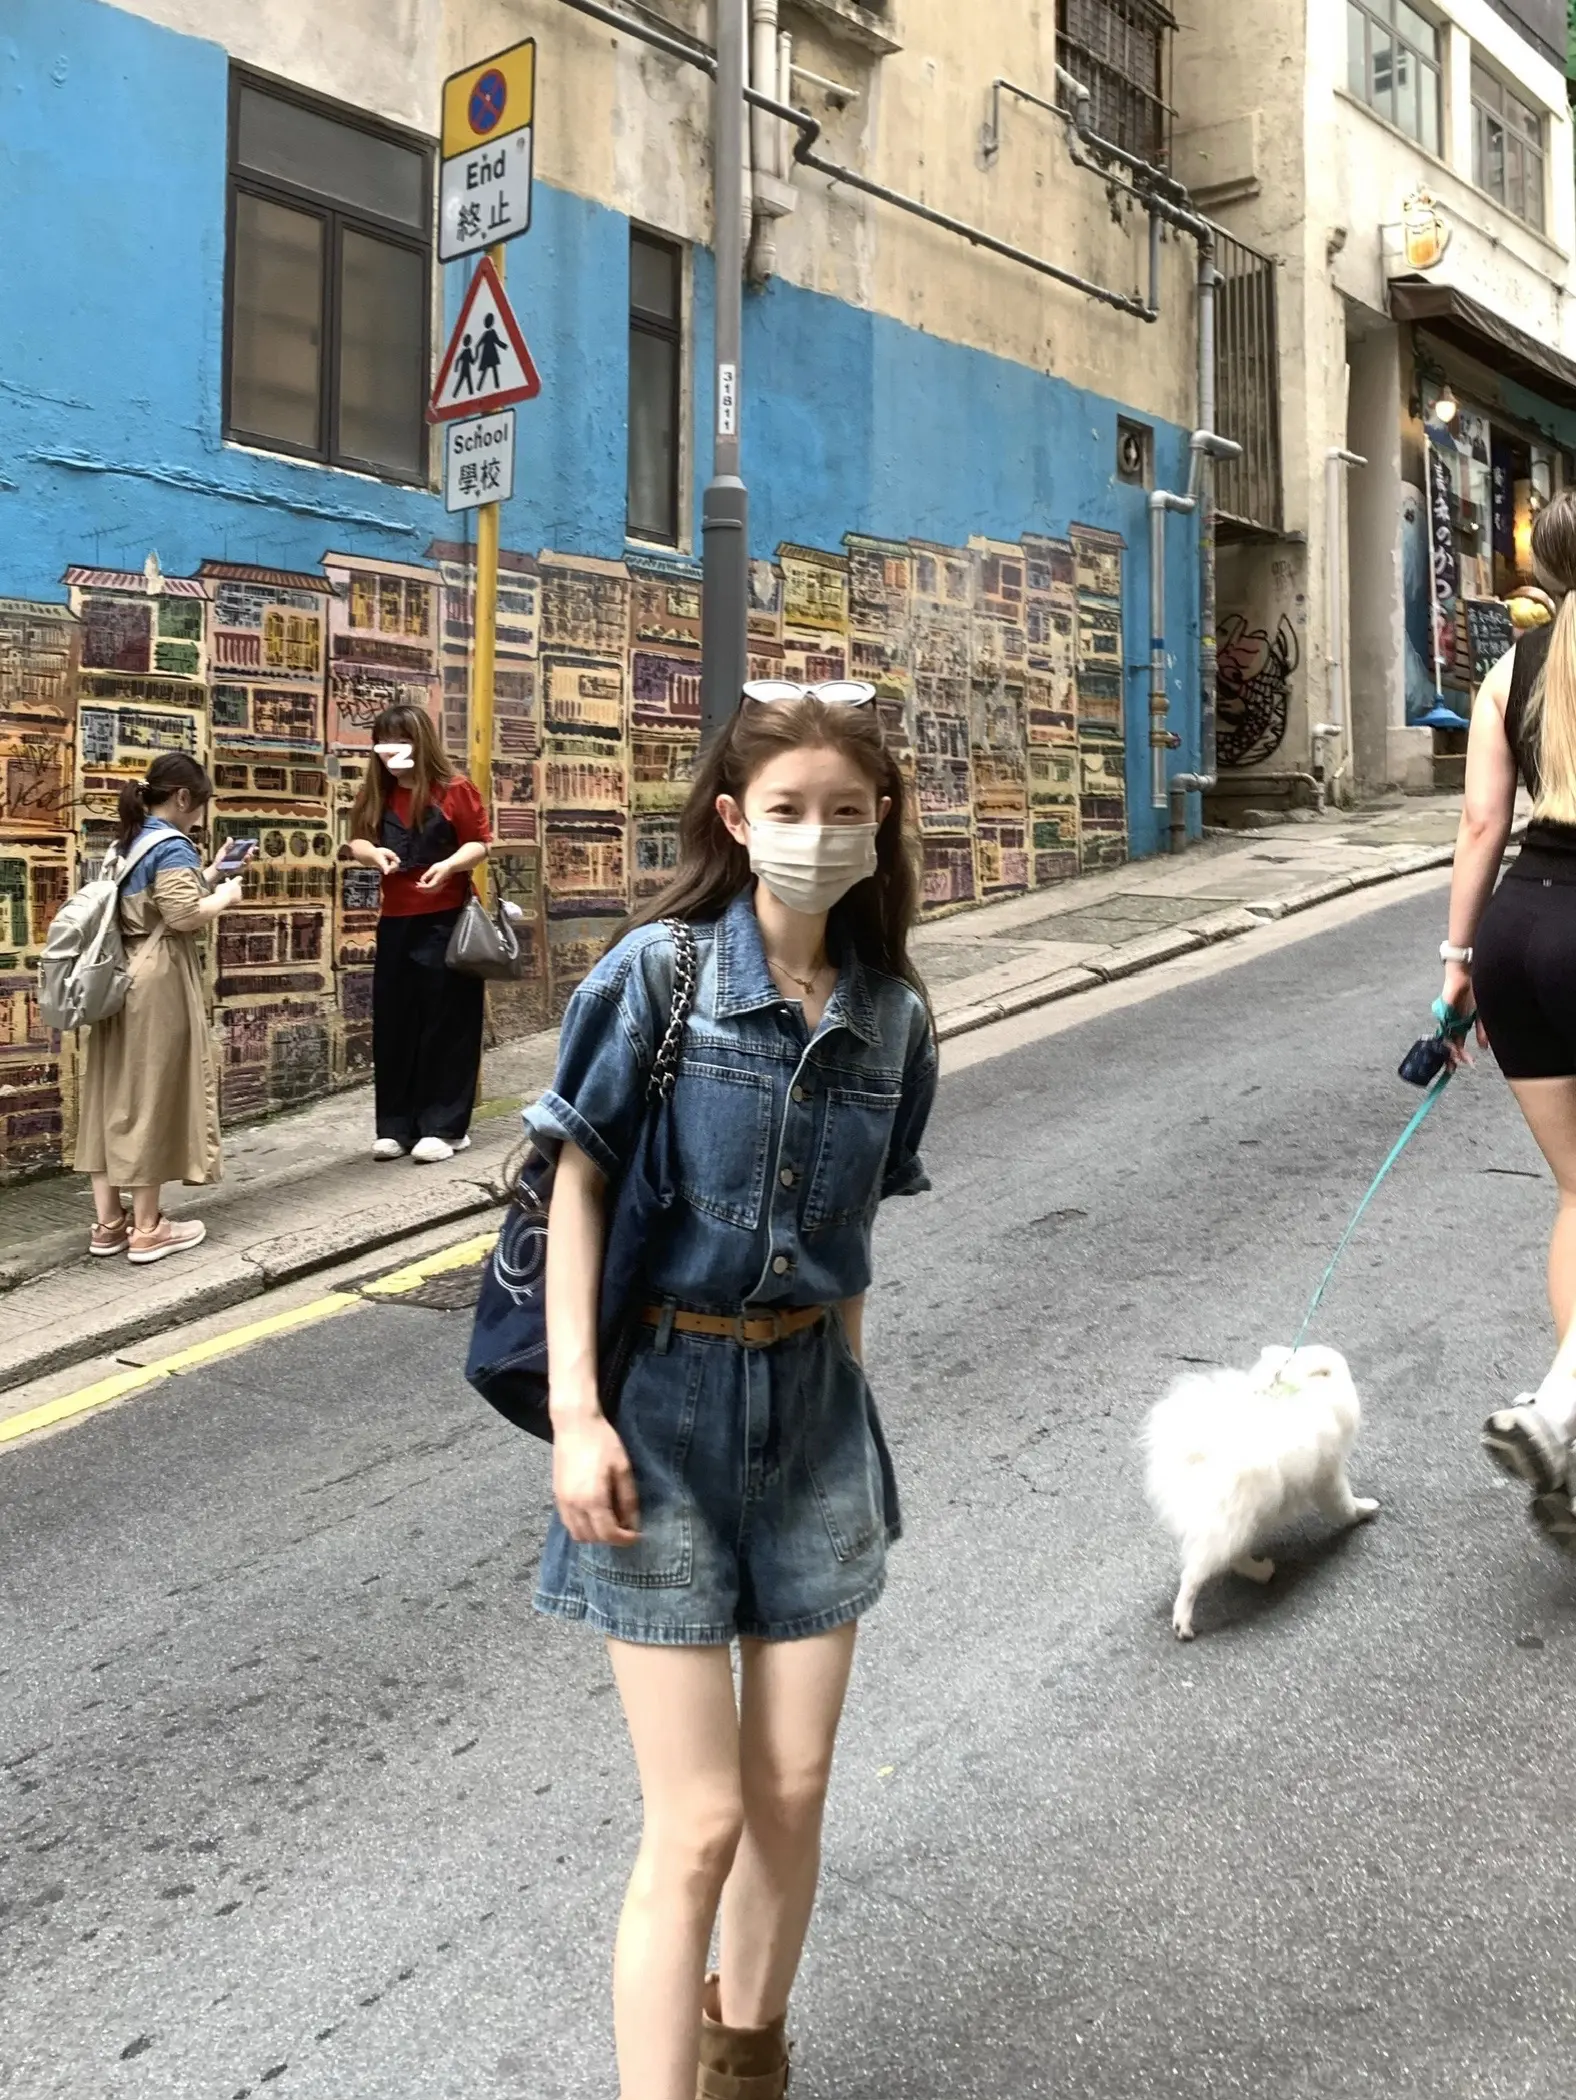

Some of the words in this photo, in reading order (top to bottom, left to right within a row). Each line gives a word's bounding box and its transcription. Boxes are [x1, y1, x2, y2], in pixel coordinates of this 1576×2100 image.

[466, 149, 506, 190] End
[456, 190, 512, 242] 終止
[453, 423, 508, 454] School
[458, 457, 501, 495] 學校
